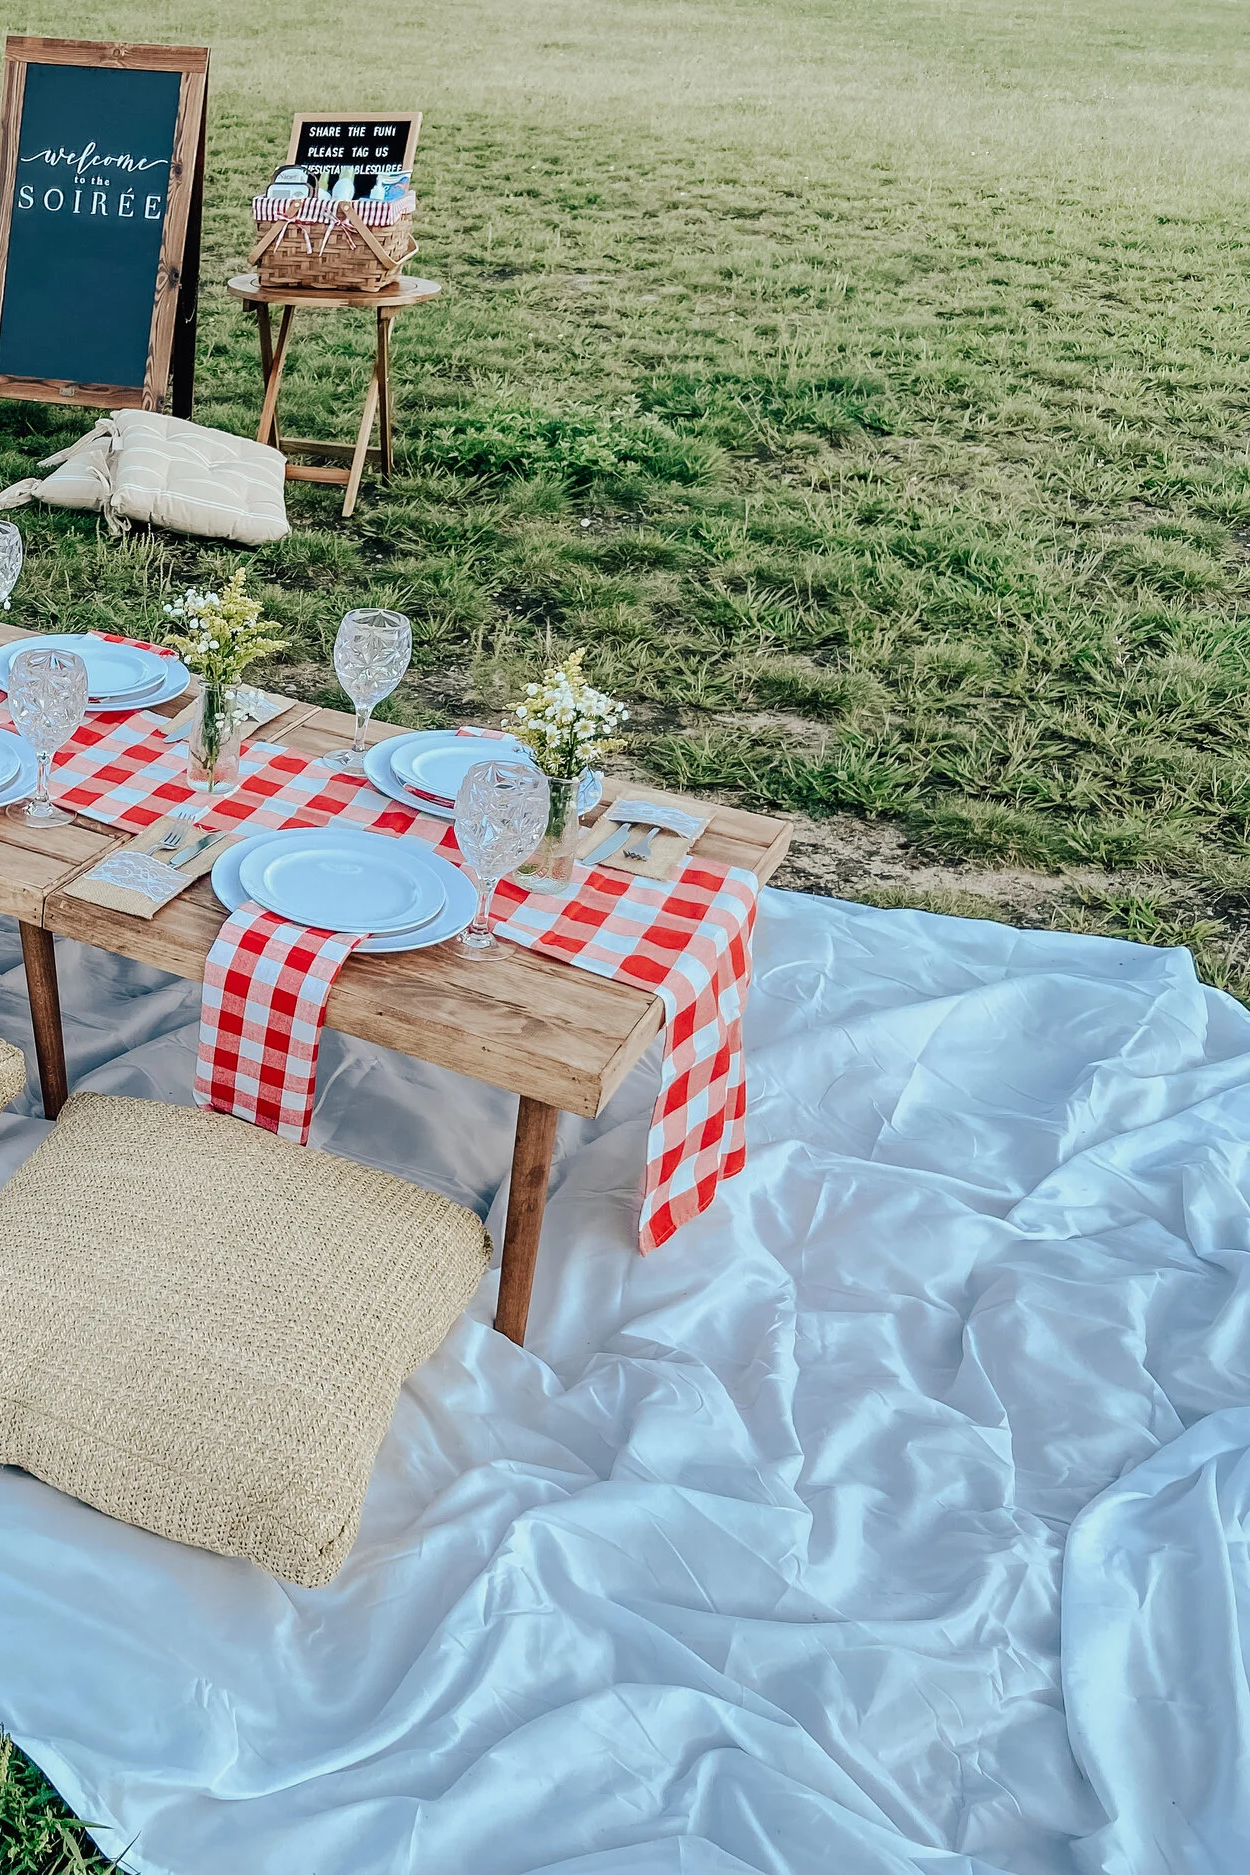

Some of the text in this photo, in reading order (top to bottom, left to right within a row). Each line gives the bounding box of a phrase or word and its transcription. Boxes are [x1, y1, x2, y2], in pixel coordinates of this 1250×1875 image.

[309, 126, 341, 137] SHARE
[348, 126, 366, 137] THE
[21, 141, 168, 174] welcome
[307, 147, 389, 158] PLEASE TAG US
[74, 175, 110, 186] to the
[18, 185, 161, 220] SOIRÉE
